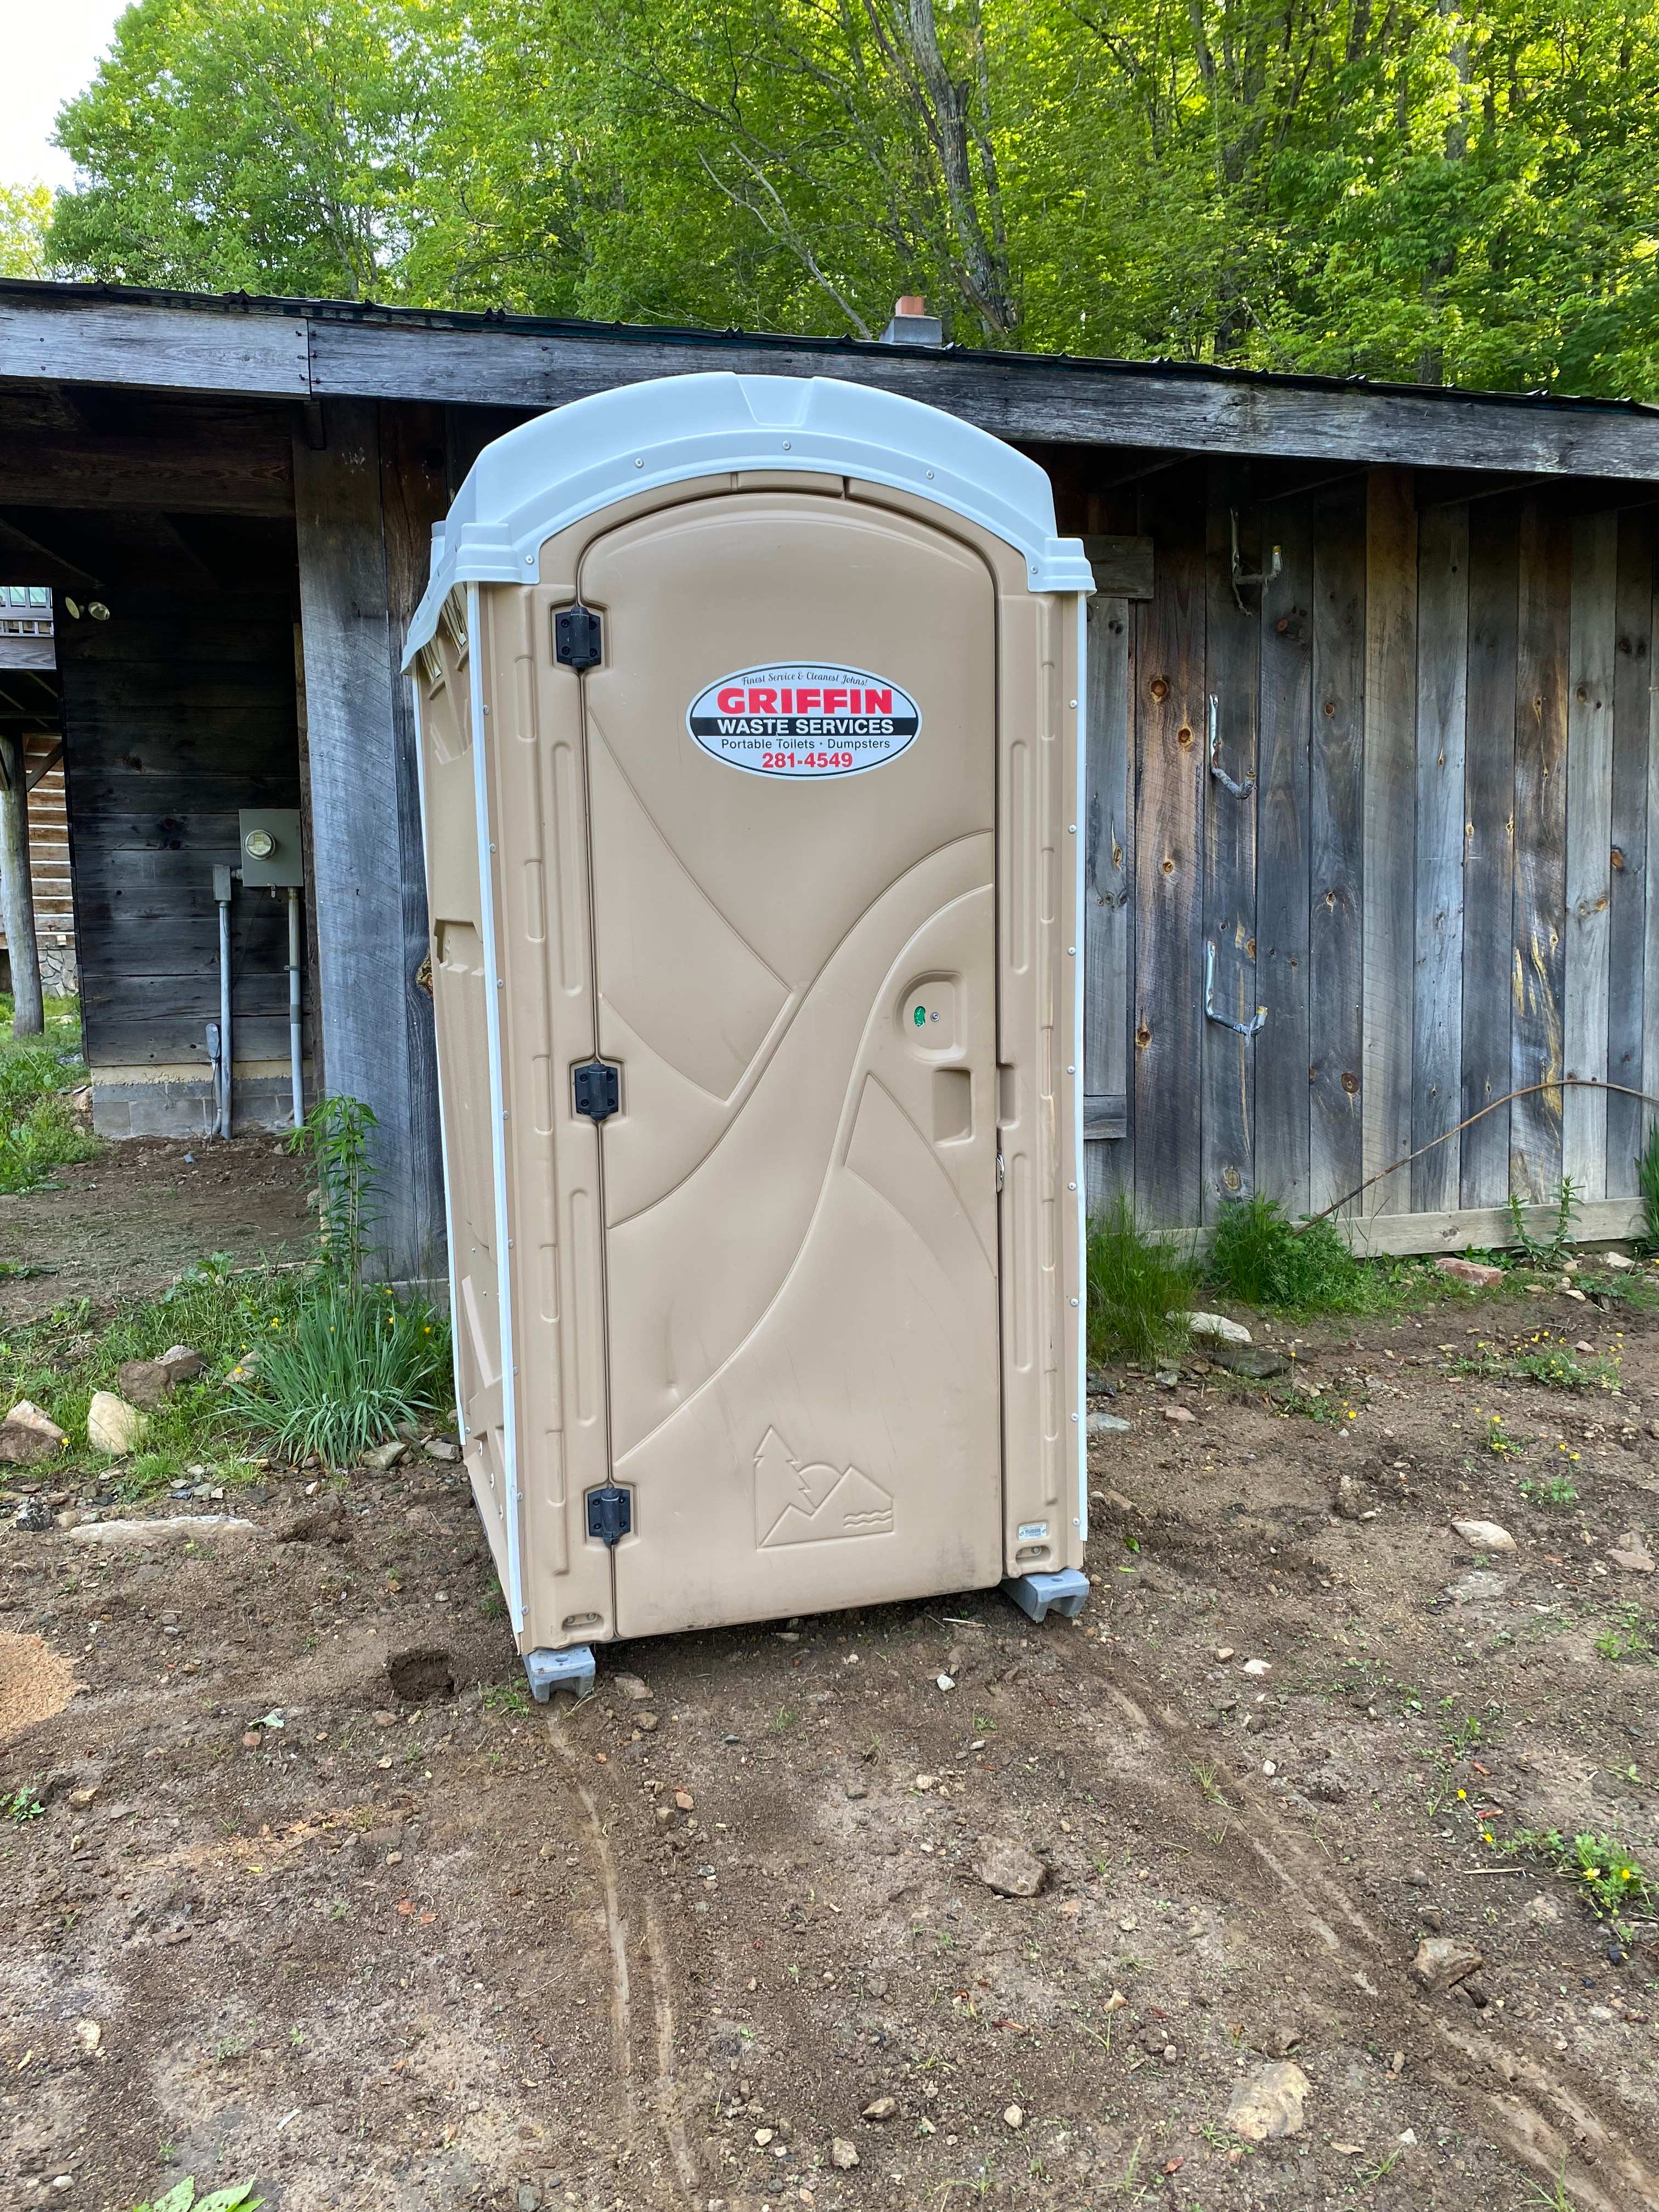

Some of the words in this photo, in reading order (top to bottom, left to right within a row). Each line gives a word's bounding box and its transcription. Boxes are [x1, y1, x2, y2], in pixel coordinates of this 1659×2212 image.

[742, 675, 765, 685] Finest
[769, 673, 795, 681] Service
[798, 671, 803, 680] &
[806, 672, 839, 681] Cleanest
[841, 674, 868, 686] Johns!
[717, 687, 893, 714] GRIFFIN
[717, 719, 789, 733] WASTE
[796, 719, 894, 733] SERVICES
[721, 738, 772, 749] Portable
[776, 739, 815, 749] Toilets
[828, 738, 890, 751] Dumpsters
[762, 752, 853, 768] 281-4549
